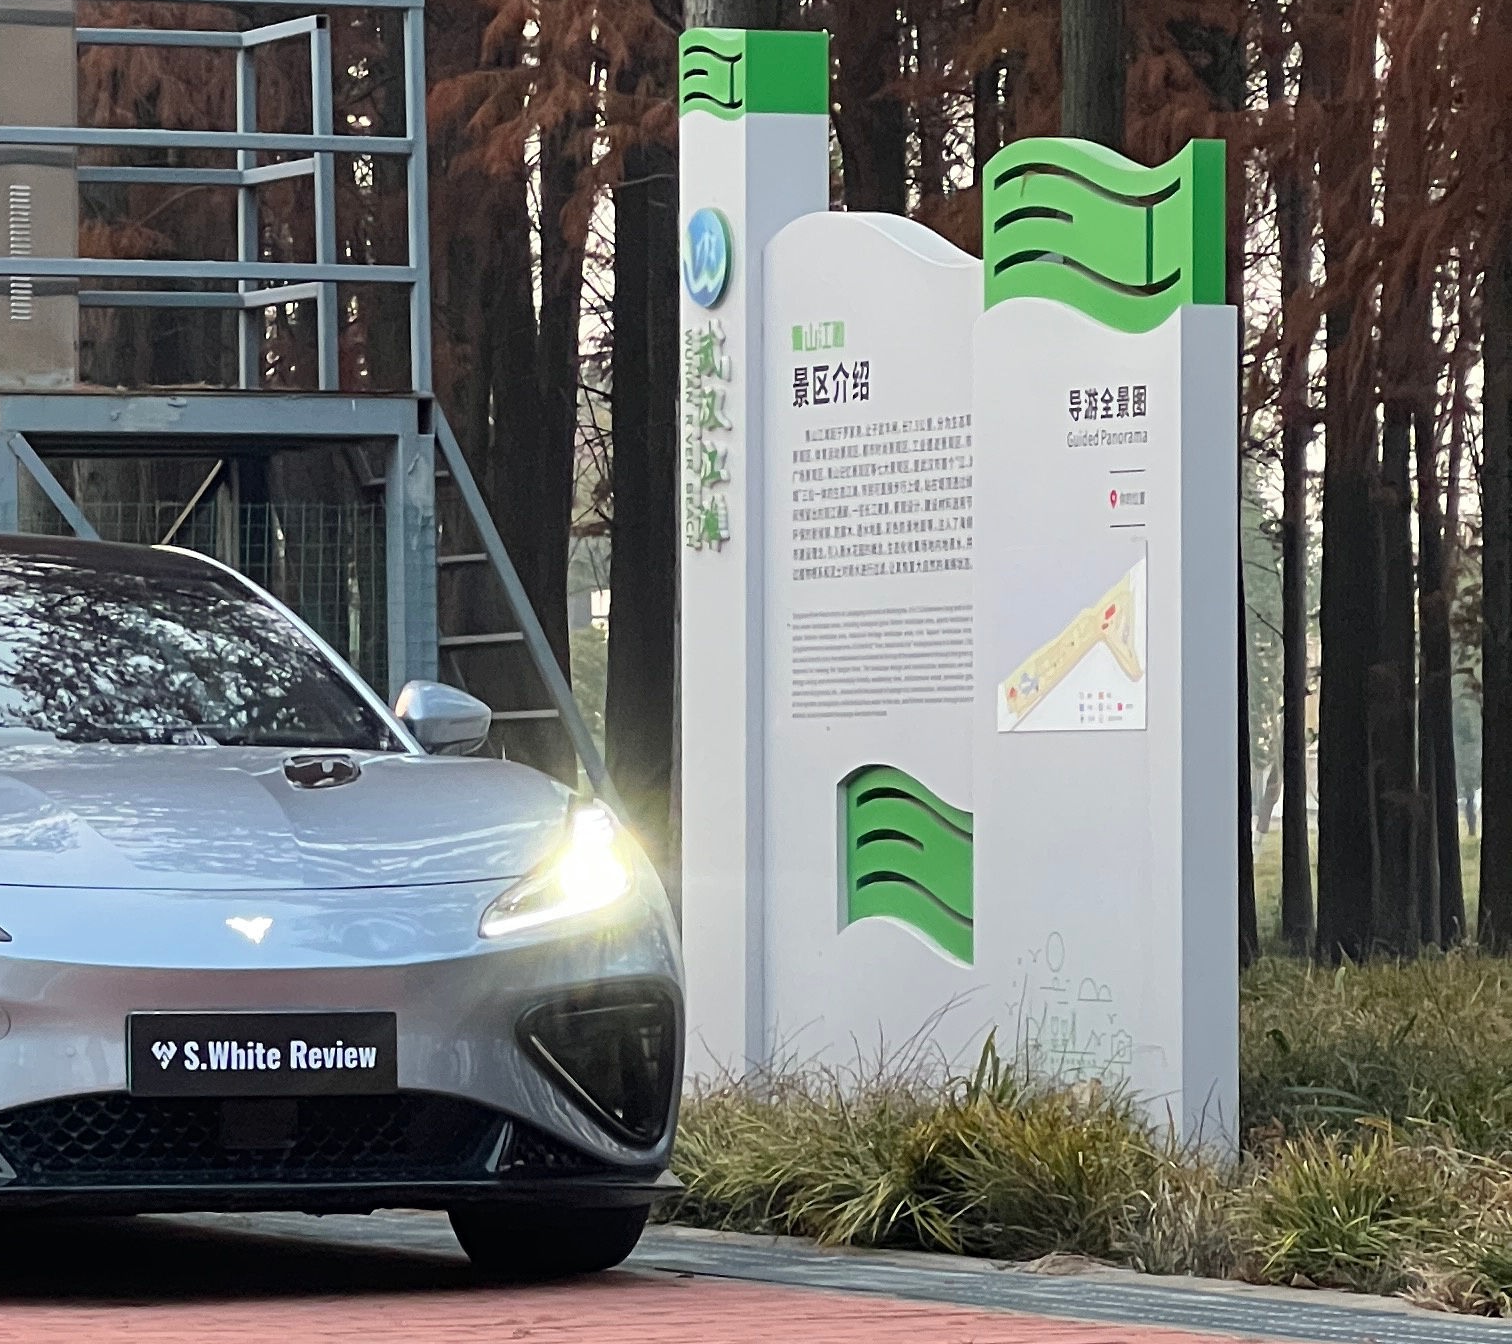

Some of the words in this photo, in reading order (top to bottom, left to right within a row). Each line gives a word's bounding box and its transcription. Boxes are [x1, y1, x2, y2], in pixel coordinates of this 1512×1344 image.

[792, 320, 845, 352] 山江
[685, 329, 694, 404] WUHAN
[792, 360, 870, 408] 景区介绍
[1068, 385, 1147, 422] 导游全景图
[685, 414, 693, 470] RVER
[1066, 428, 1100, 448] Guided
[1100, 429, 1148, 446] Panorama
[685, 483, 694, 548] BEACH
[184, 1040, 281, 1071] S.White
[289, 1040, 378, 1070] Review
